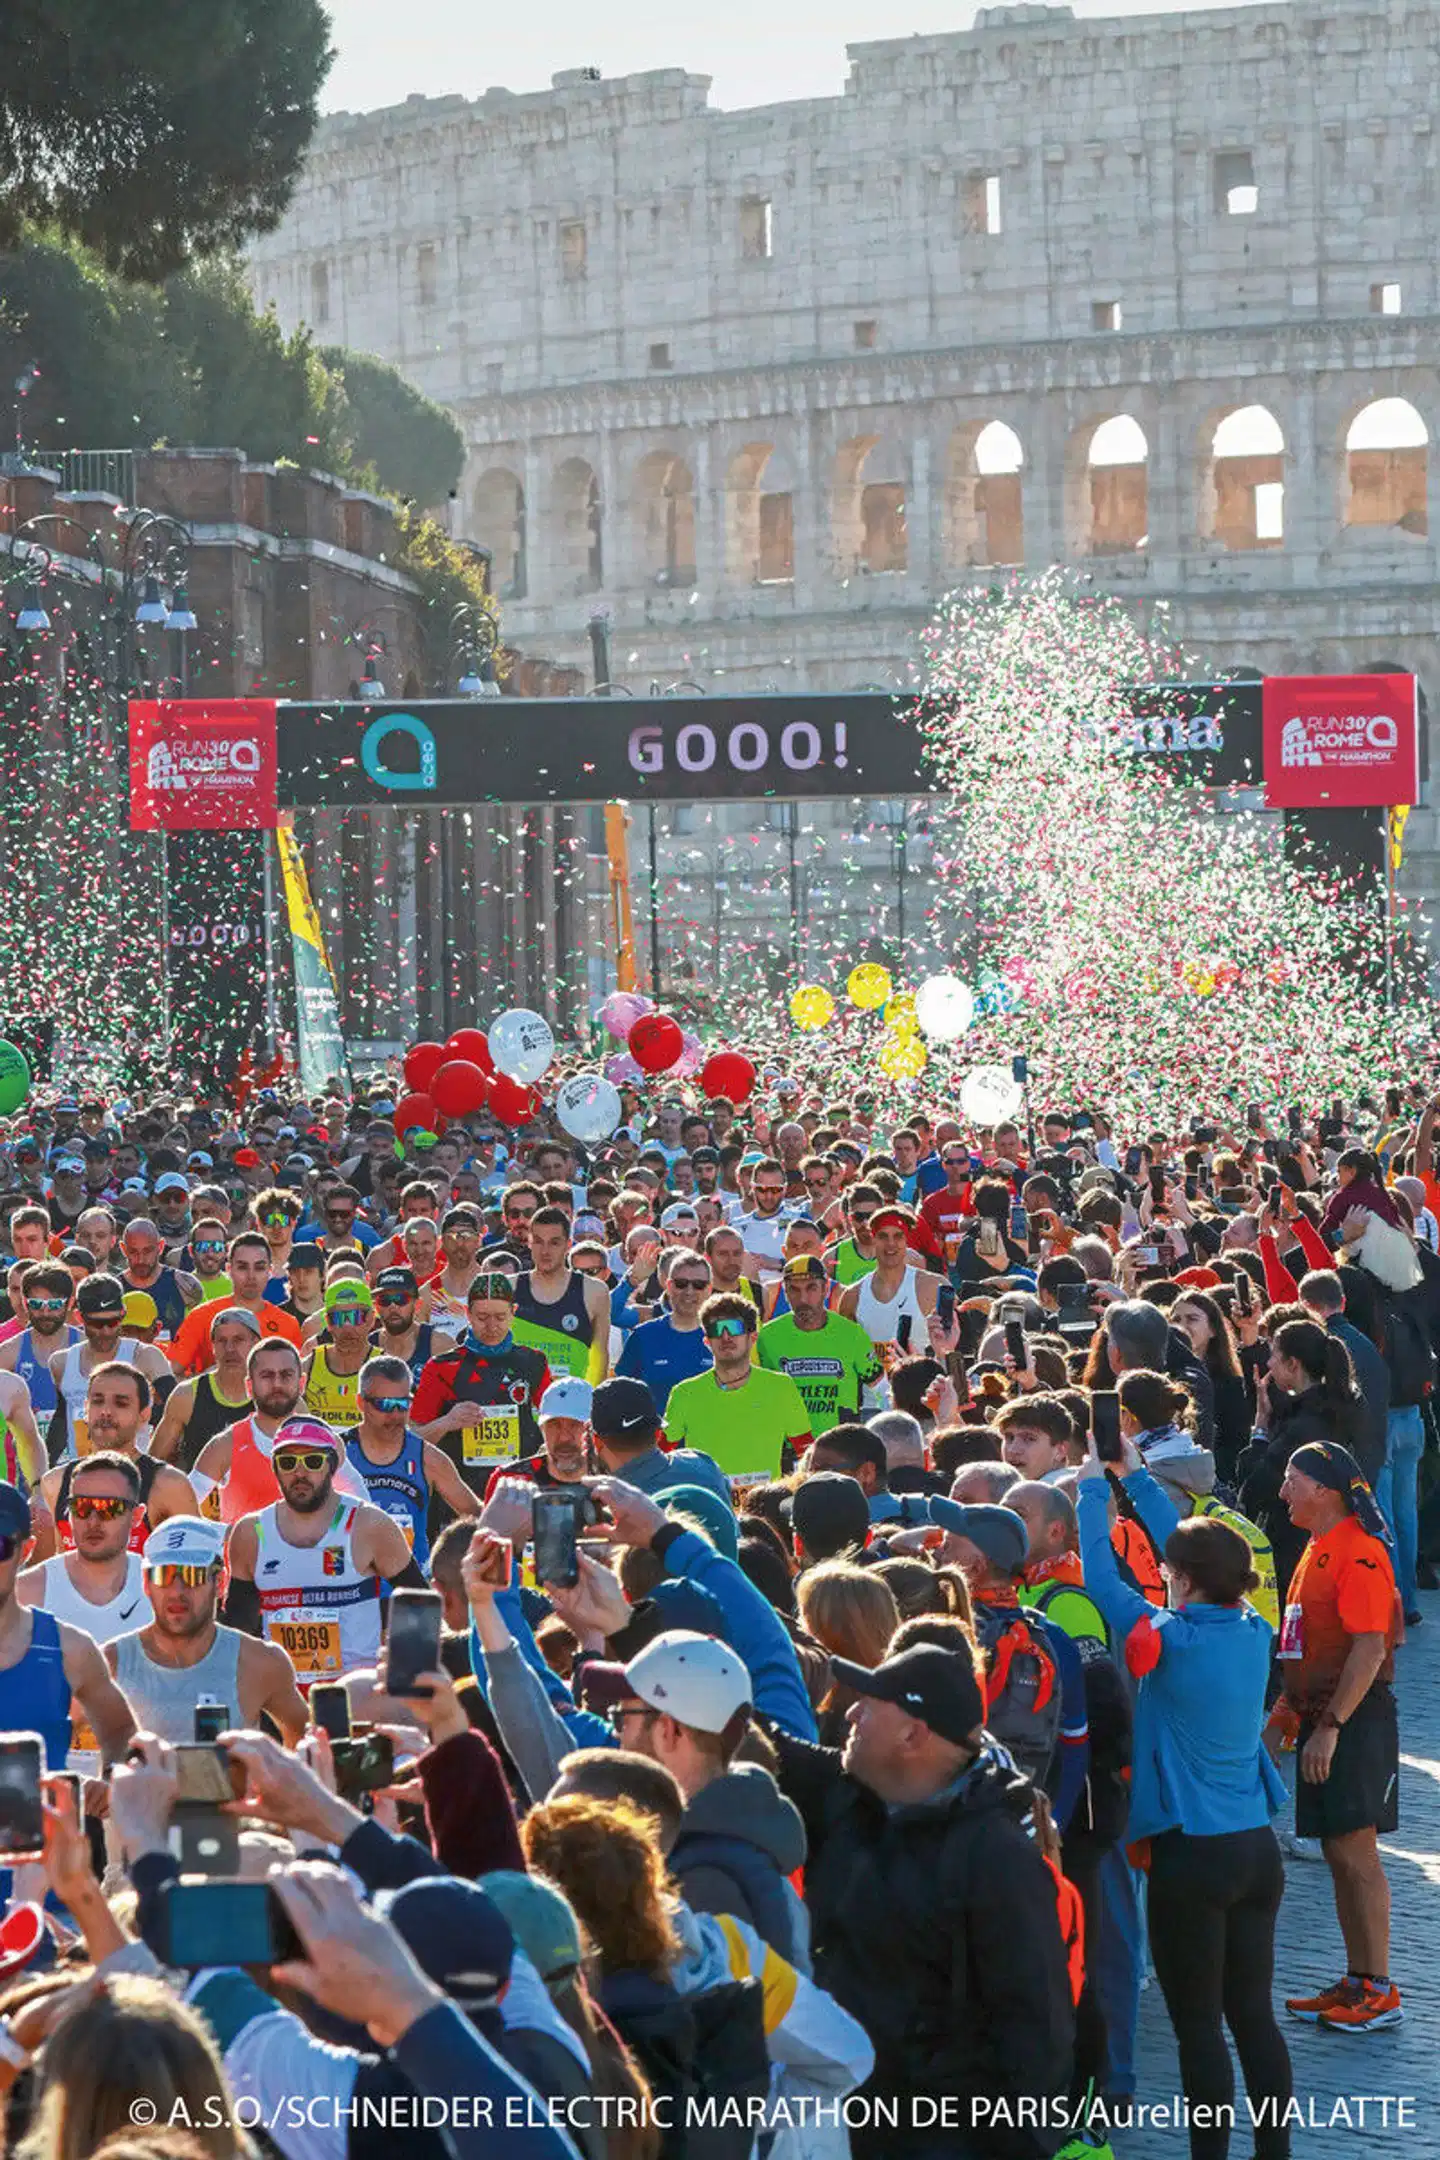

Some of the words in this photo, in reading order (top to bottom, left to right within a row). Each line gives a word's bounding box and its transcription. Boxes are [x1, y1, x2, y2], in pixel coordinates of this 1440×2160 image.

[627, 721, 849, 773] GOOO!
[1314, 733, 1365, 747] ROME
[1339, 751, 1391, 761] MARATHON
[797, 1384, 839, 1398] TLETA
[280, 1626, 330, 1650] 10369
